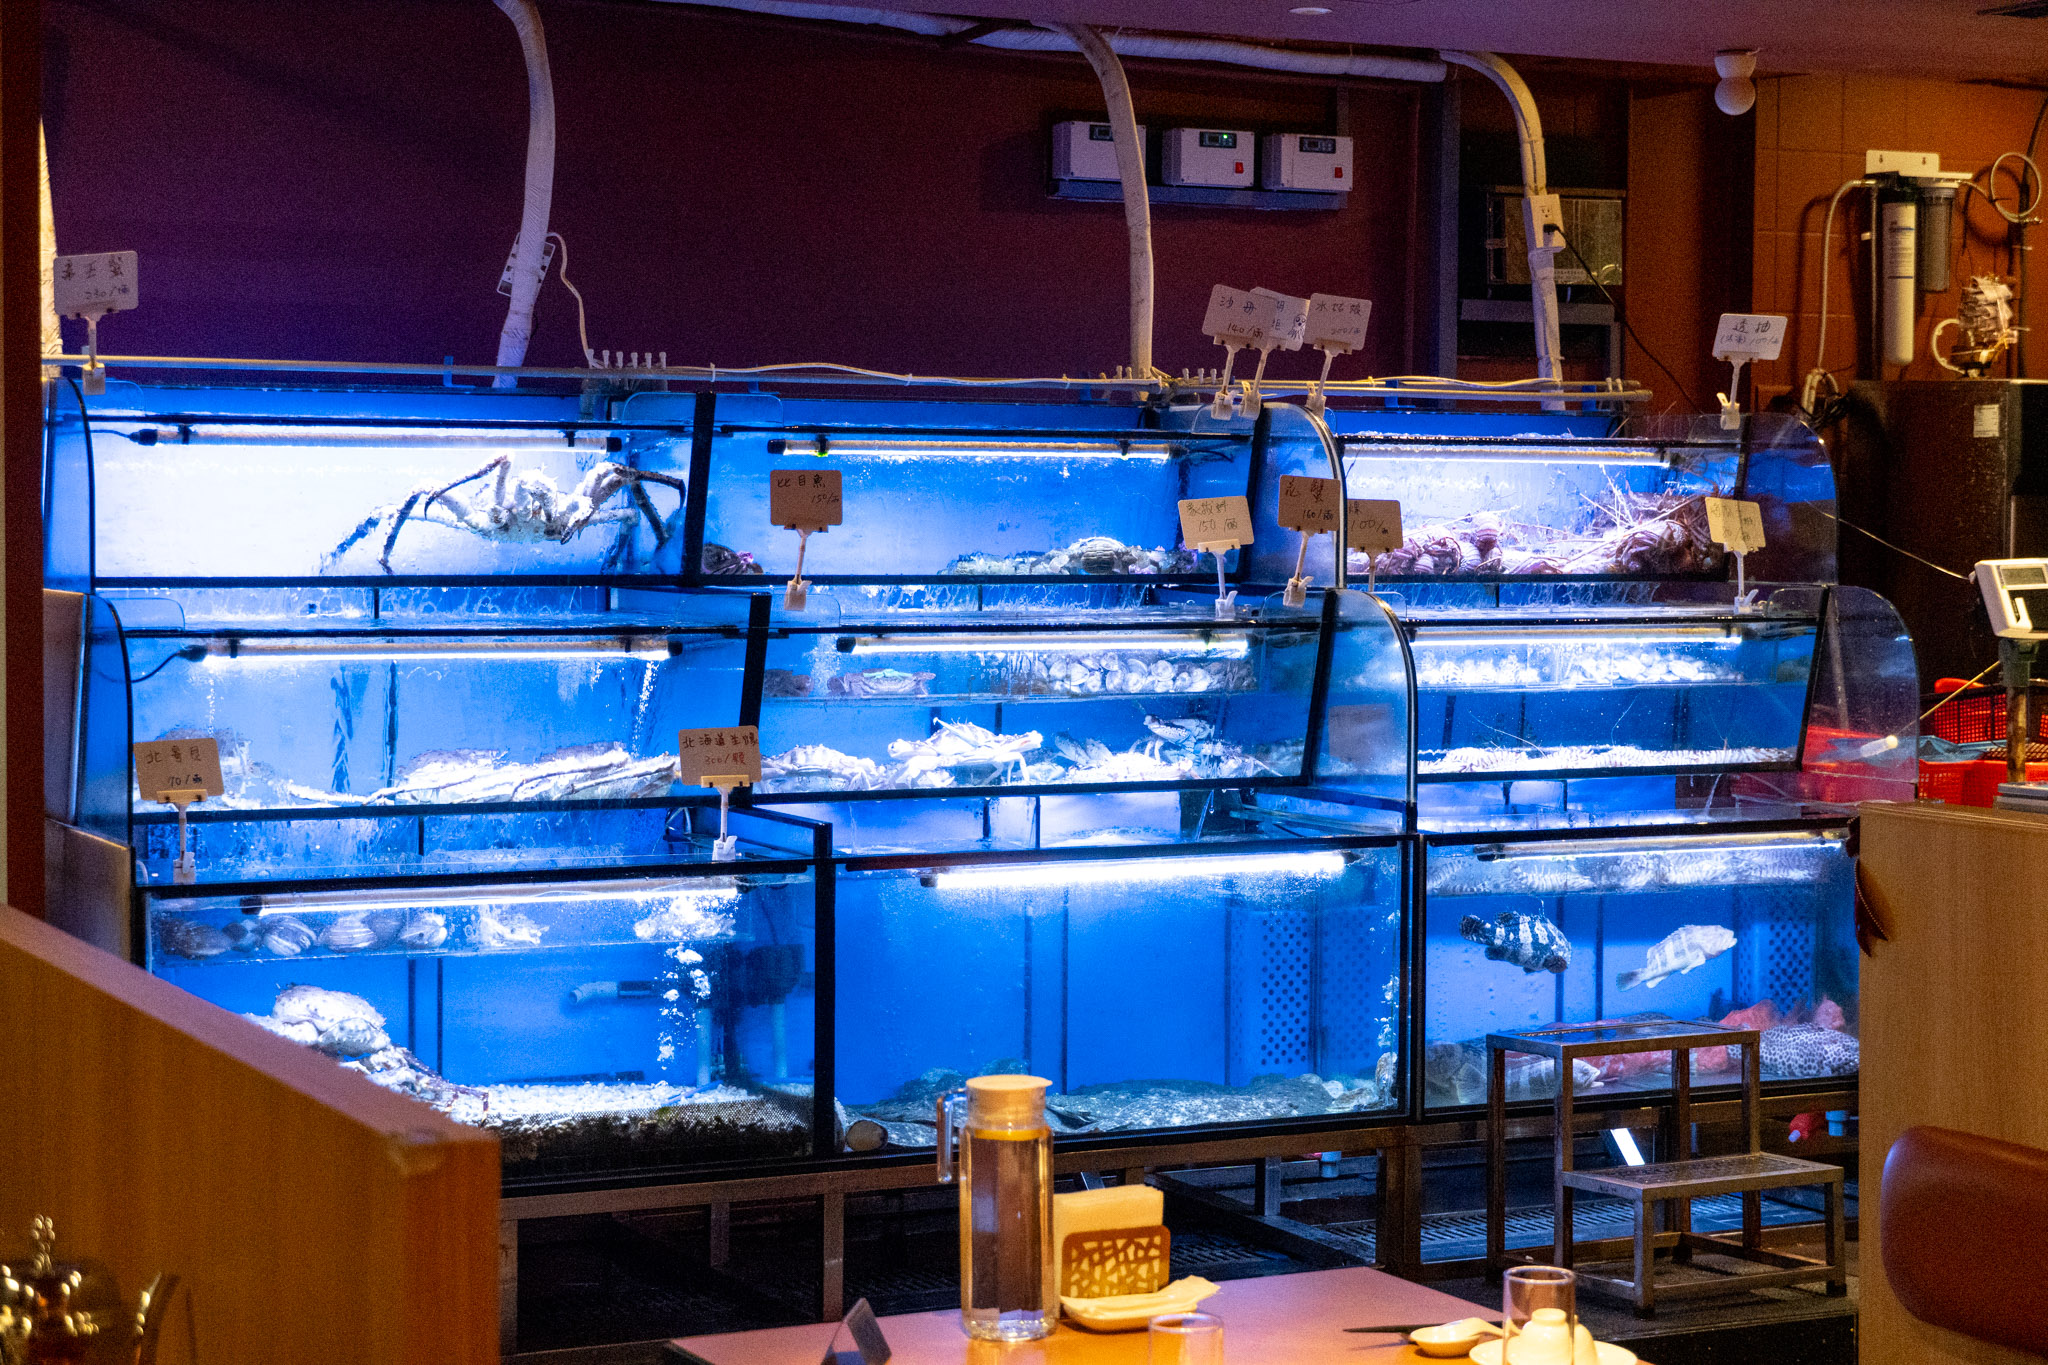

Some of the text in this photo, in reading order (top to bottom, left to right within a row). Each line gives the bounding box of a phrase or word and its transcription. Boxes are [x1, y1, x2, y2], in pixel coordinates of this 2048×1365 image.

[1732, 318, 1771, 334] 透抽
[777, 473, 826, 489] 比目魚
